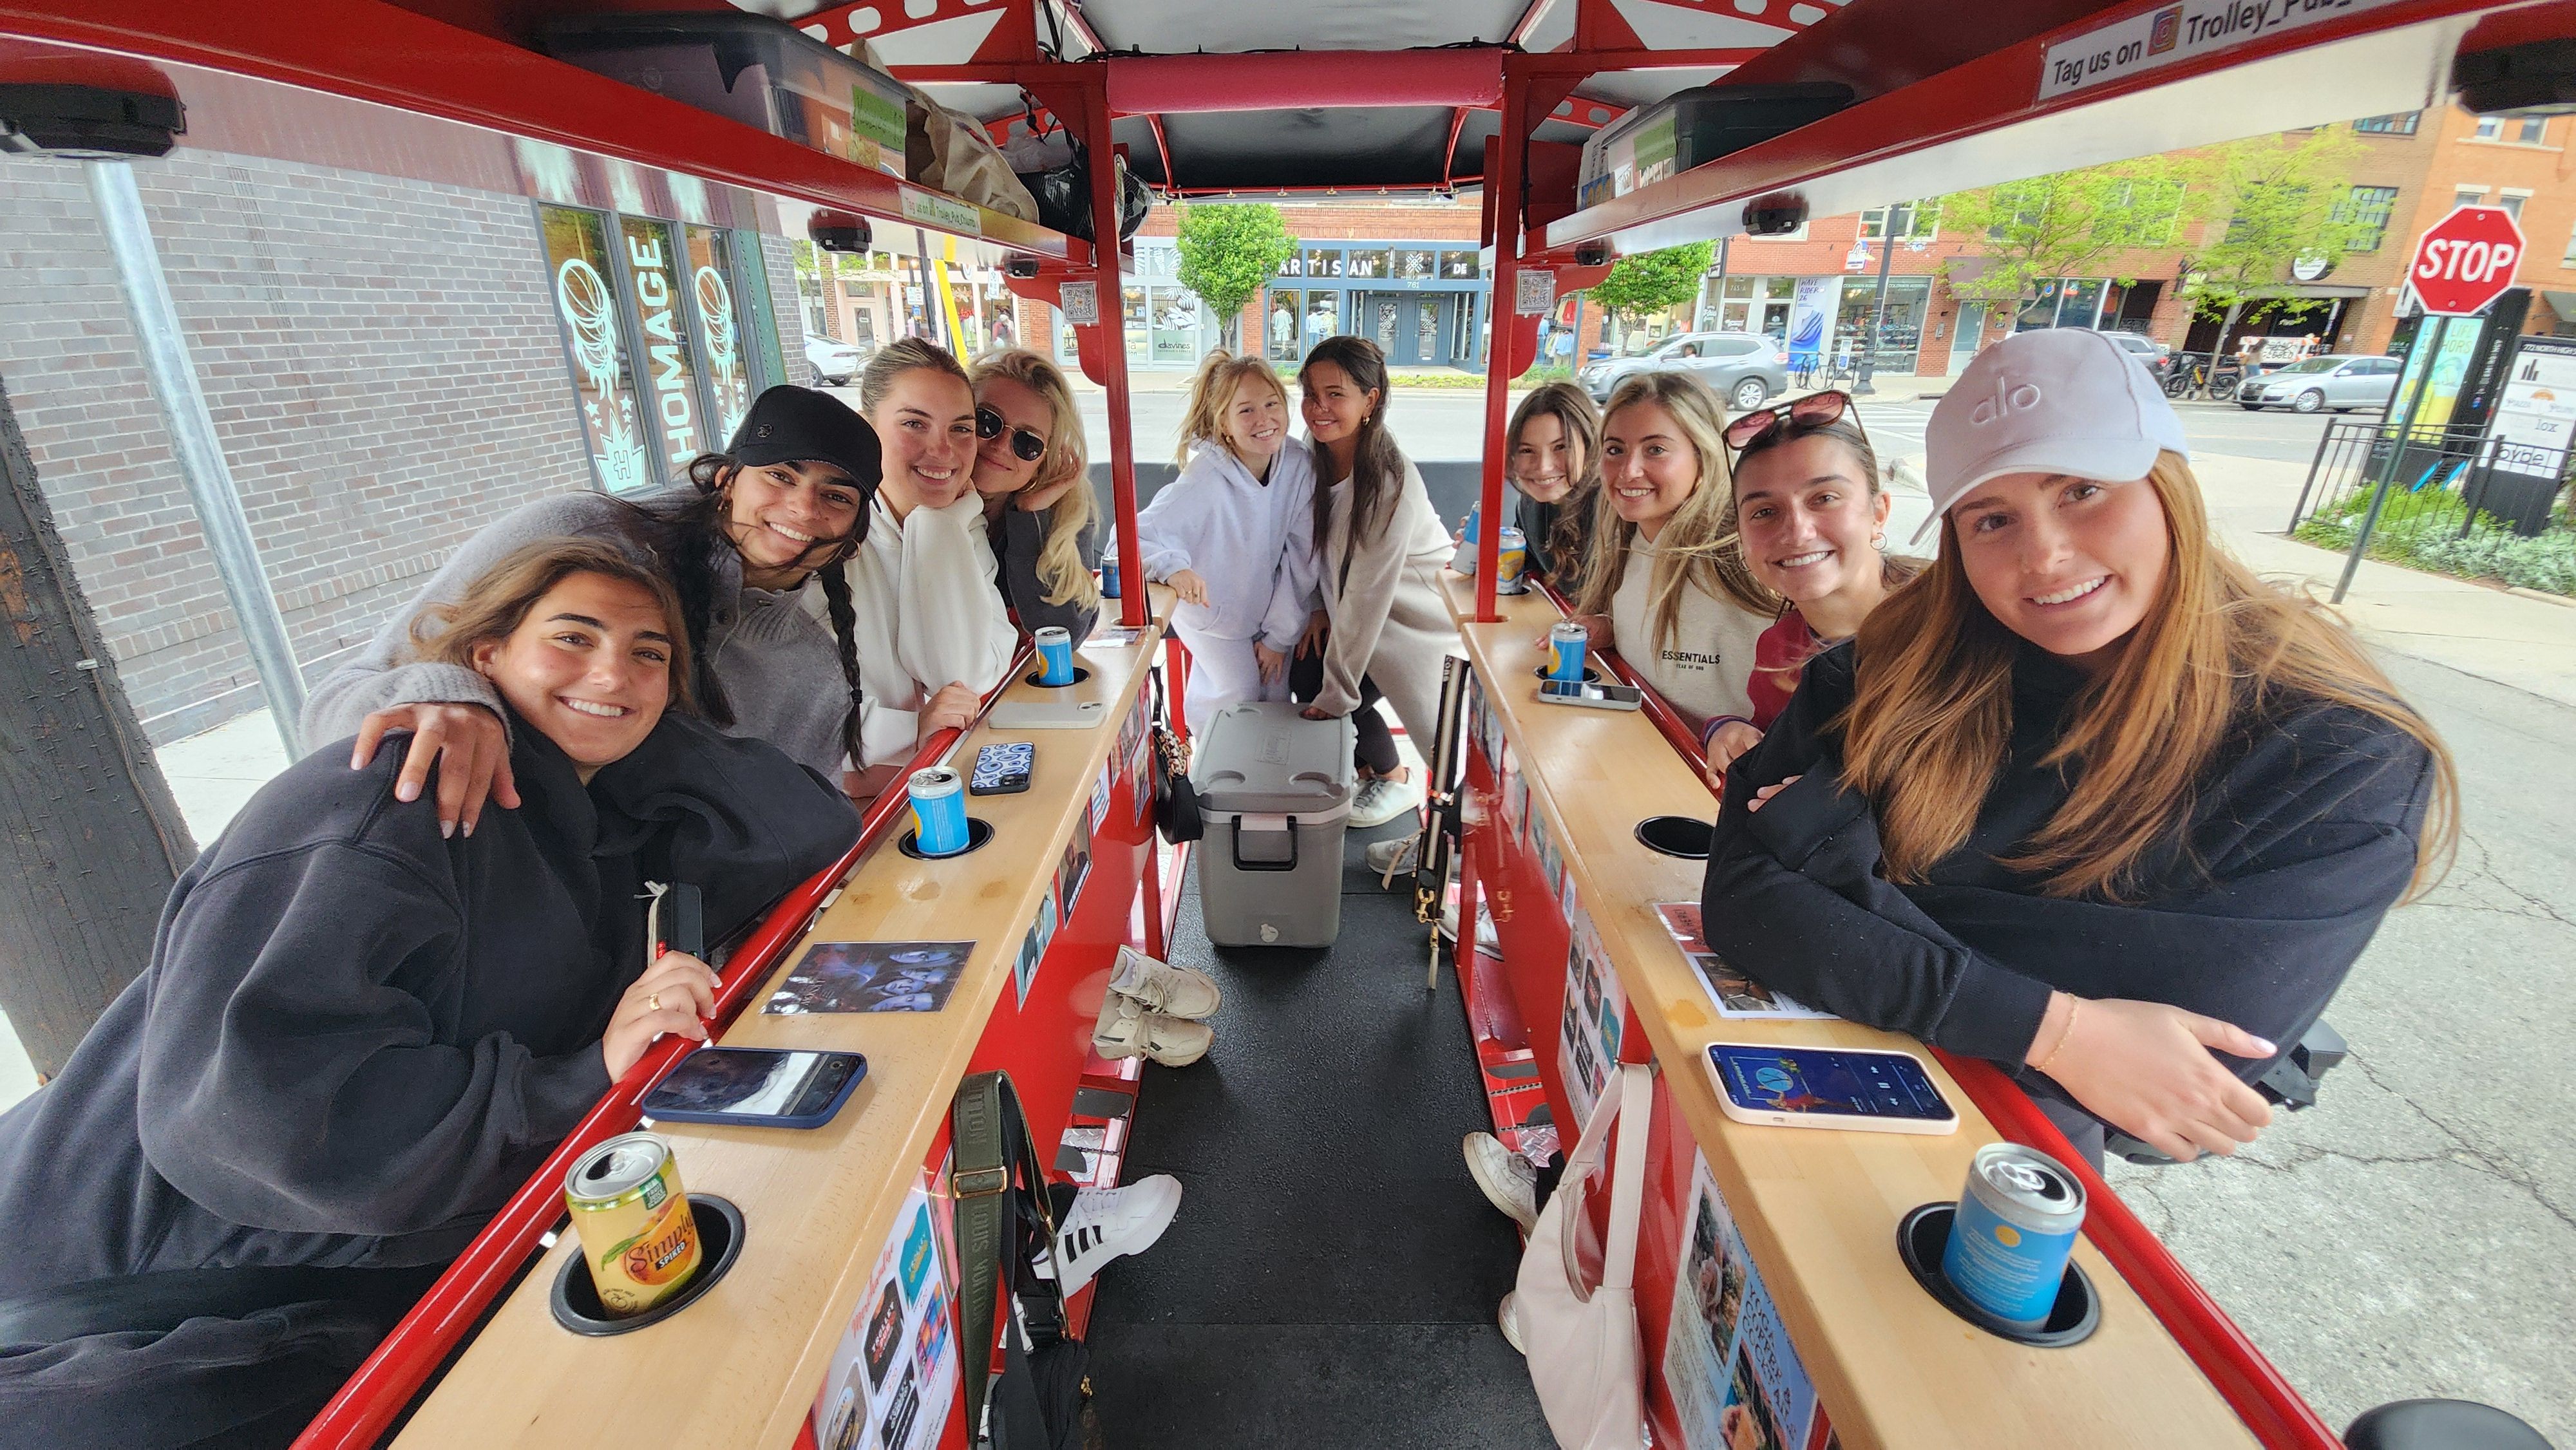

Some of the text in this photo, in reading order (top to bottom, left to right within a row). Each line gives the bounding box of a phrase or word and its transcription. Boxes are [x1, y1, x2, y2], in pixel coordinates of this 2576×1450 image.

[2054, 58, 2085, 86] Tag
[2088, 50, 2112, 74] us
[2116, 40, 2142, 66] on
[1278, 258, 1468, 276] ARTISAN DE
[1801, 278, 1819, 287] WAVE
[2418, 238, 2515, 283] STOP
[629, 236, 697, 464] HOMAGE
[1158, 338, 1191, 349] davines
[1971, 376, 2041, 425] alo
[2535, 419, 2560, 433] lox
[1662, 650, 1721, 664] ESSENTIALS
[629, 1211, 694, 1273] Simply
[972, 1203, 990, 1253] LOUIS
[658, 1241, 687, 1268] SPIKED
[871, 1301, 895, 1353] TROLLEY
[1749, 1281, 1776, 1347] YOGA
